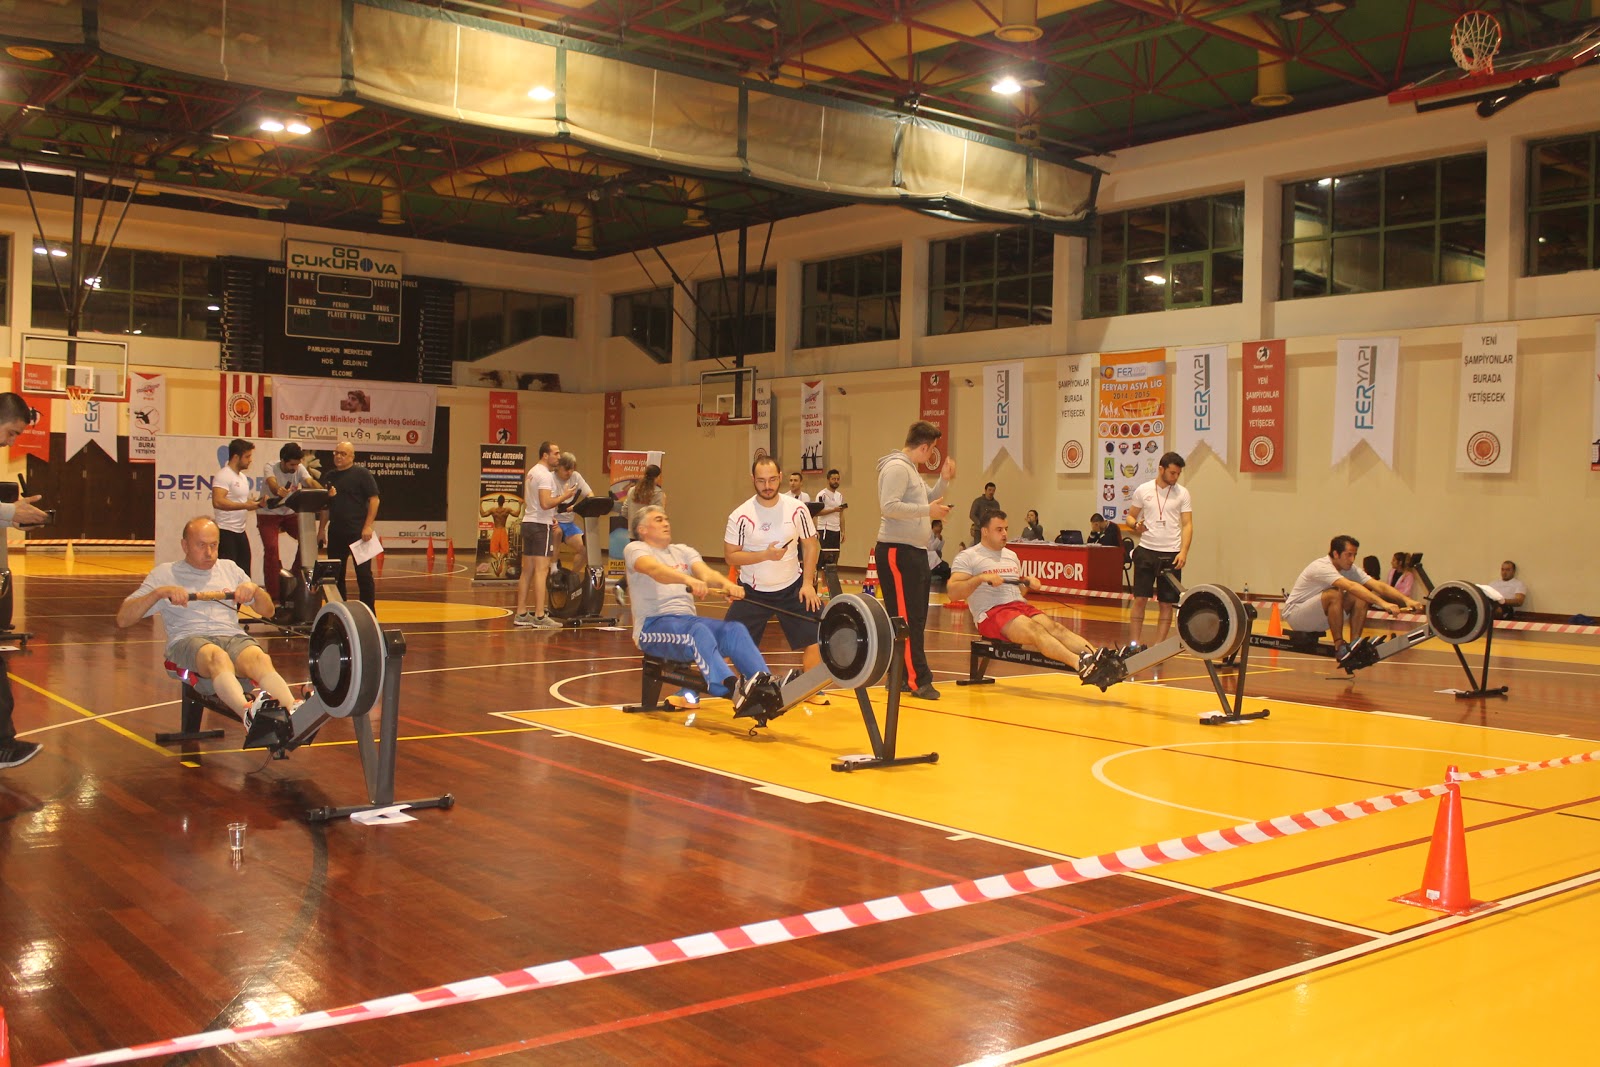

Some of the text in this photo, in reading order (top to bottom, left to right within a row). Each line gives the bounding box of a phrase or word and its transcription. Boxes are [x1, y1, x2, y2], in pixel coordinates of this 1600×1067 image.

[332, 247, 360, 259] GO
[268, 266, 286, 275] FOULS
[290, 271, 315, 281] HOME
[373, 279, 399, 289] VISITOR
[402, 280, 418, 289] FOULS
[298, 297, 317, 306] BONUS
[332, 301, 350, 309] PERIOD
[293, 307, 311, 316] FOULS
[372, 304, 390, 313] BONUS
[327, 310, 366, 321] PLAYER FOULS
[378, 315, 394, 323] FOULS
[1481, 334, 1498, 346] YENİ
[307, 345, 340, 354] PAMUKSPOR
[1464, 354, 1513, 367] ŞAMPİYONLAR
[1257, 375, 1269, 384] YENİ
[1472, 373, 1502, 384] BURADA
[1102, 378, 1163, 391] FERYAPI ASYA LİG
[1354, 345, 1376, 430] FERYAPI
[1134, 391, 1150, 399] 2015
[1194, 354, 1211, 431] FERYAPI
[1245, 389, 1280, 400] ŞAMPİYONLAR
[1064, 394, 1083, 403] BURADA
[1468, 391, 1506, 405] YETİŞECEK
[996, 369, 1010, 439] FERYAPI
[1251, 405, 1272, 413] BURADA
[280, 412, 426, 427] Osman Erverdi Minikler Şenliğine Hoş Geldiniz
[1248, 418, 1276, 429] YETİŞECEK
[376, 431, 401, 441] Tropicana
[1006, 650, 1027, 660] Concept
